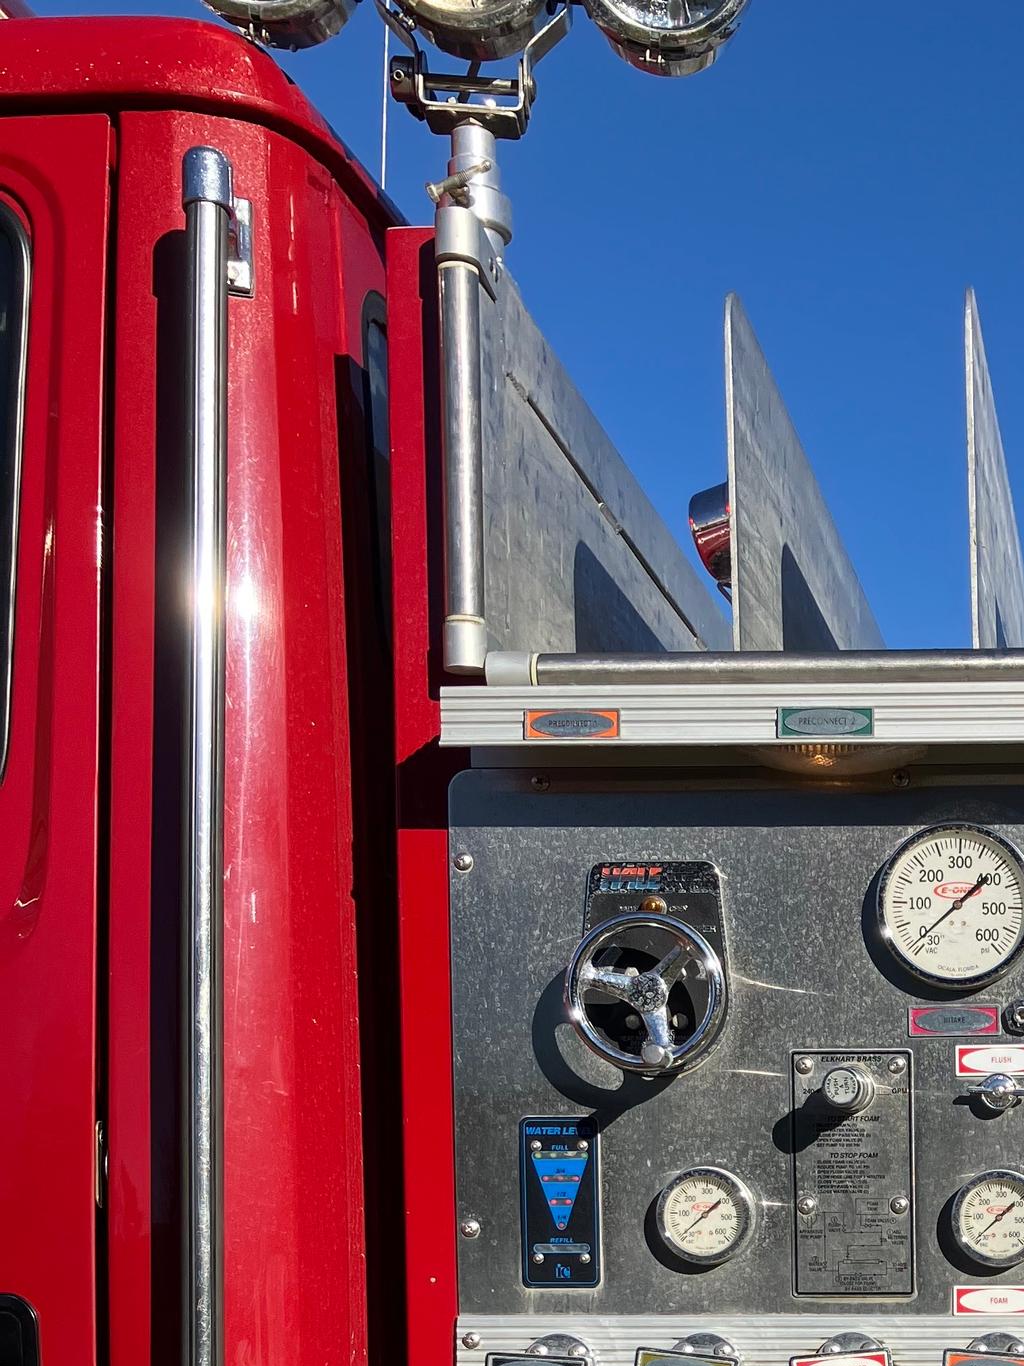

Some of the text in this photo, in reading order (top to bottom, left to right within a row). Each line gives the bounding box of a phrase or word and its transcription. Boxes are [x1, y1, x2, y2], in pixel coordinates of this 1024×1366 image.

[798, 717, 856, 726] PRECONNECT 2
[948, 856, 972, 869] 300
[919, 869, 943, 883] 200
[909, 897, 931, 910] 100
[982, 902, 1006, 915] 500
[919, 925, 927, 938] 0
[975, 929, 999, 941] 600
[981, 947, 990, 955] psi
[991, 1056, 1012, 1064] FLUSH
[526, 1127, 561, 1135] WATER
